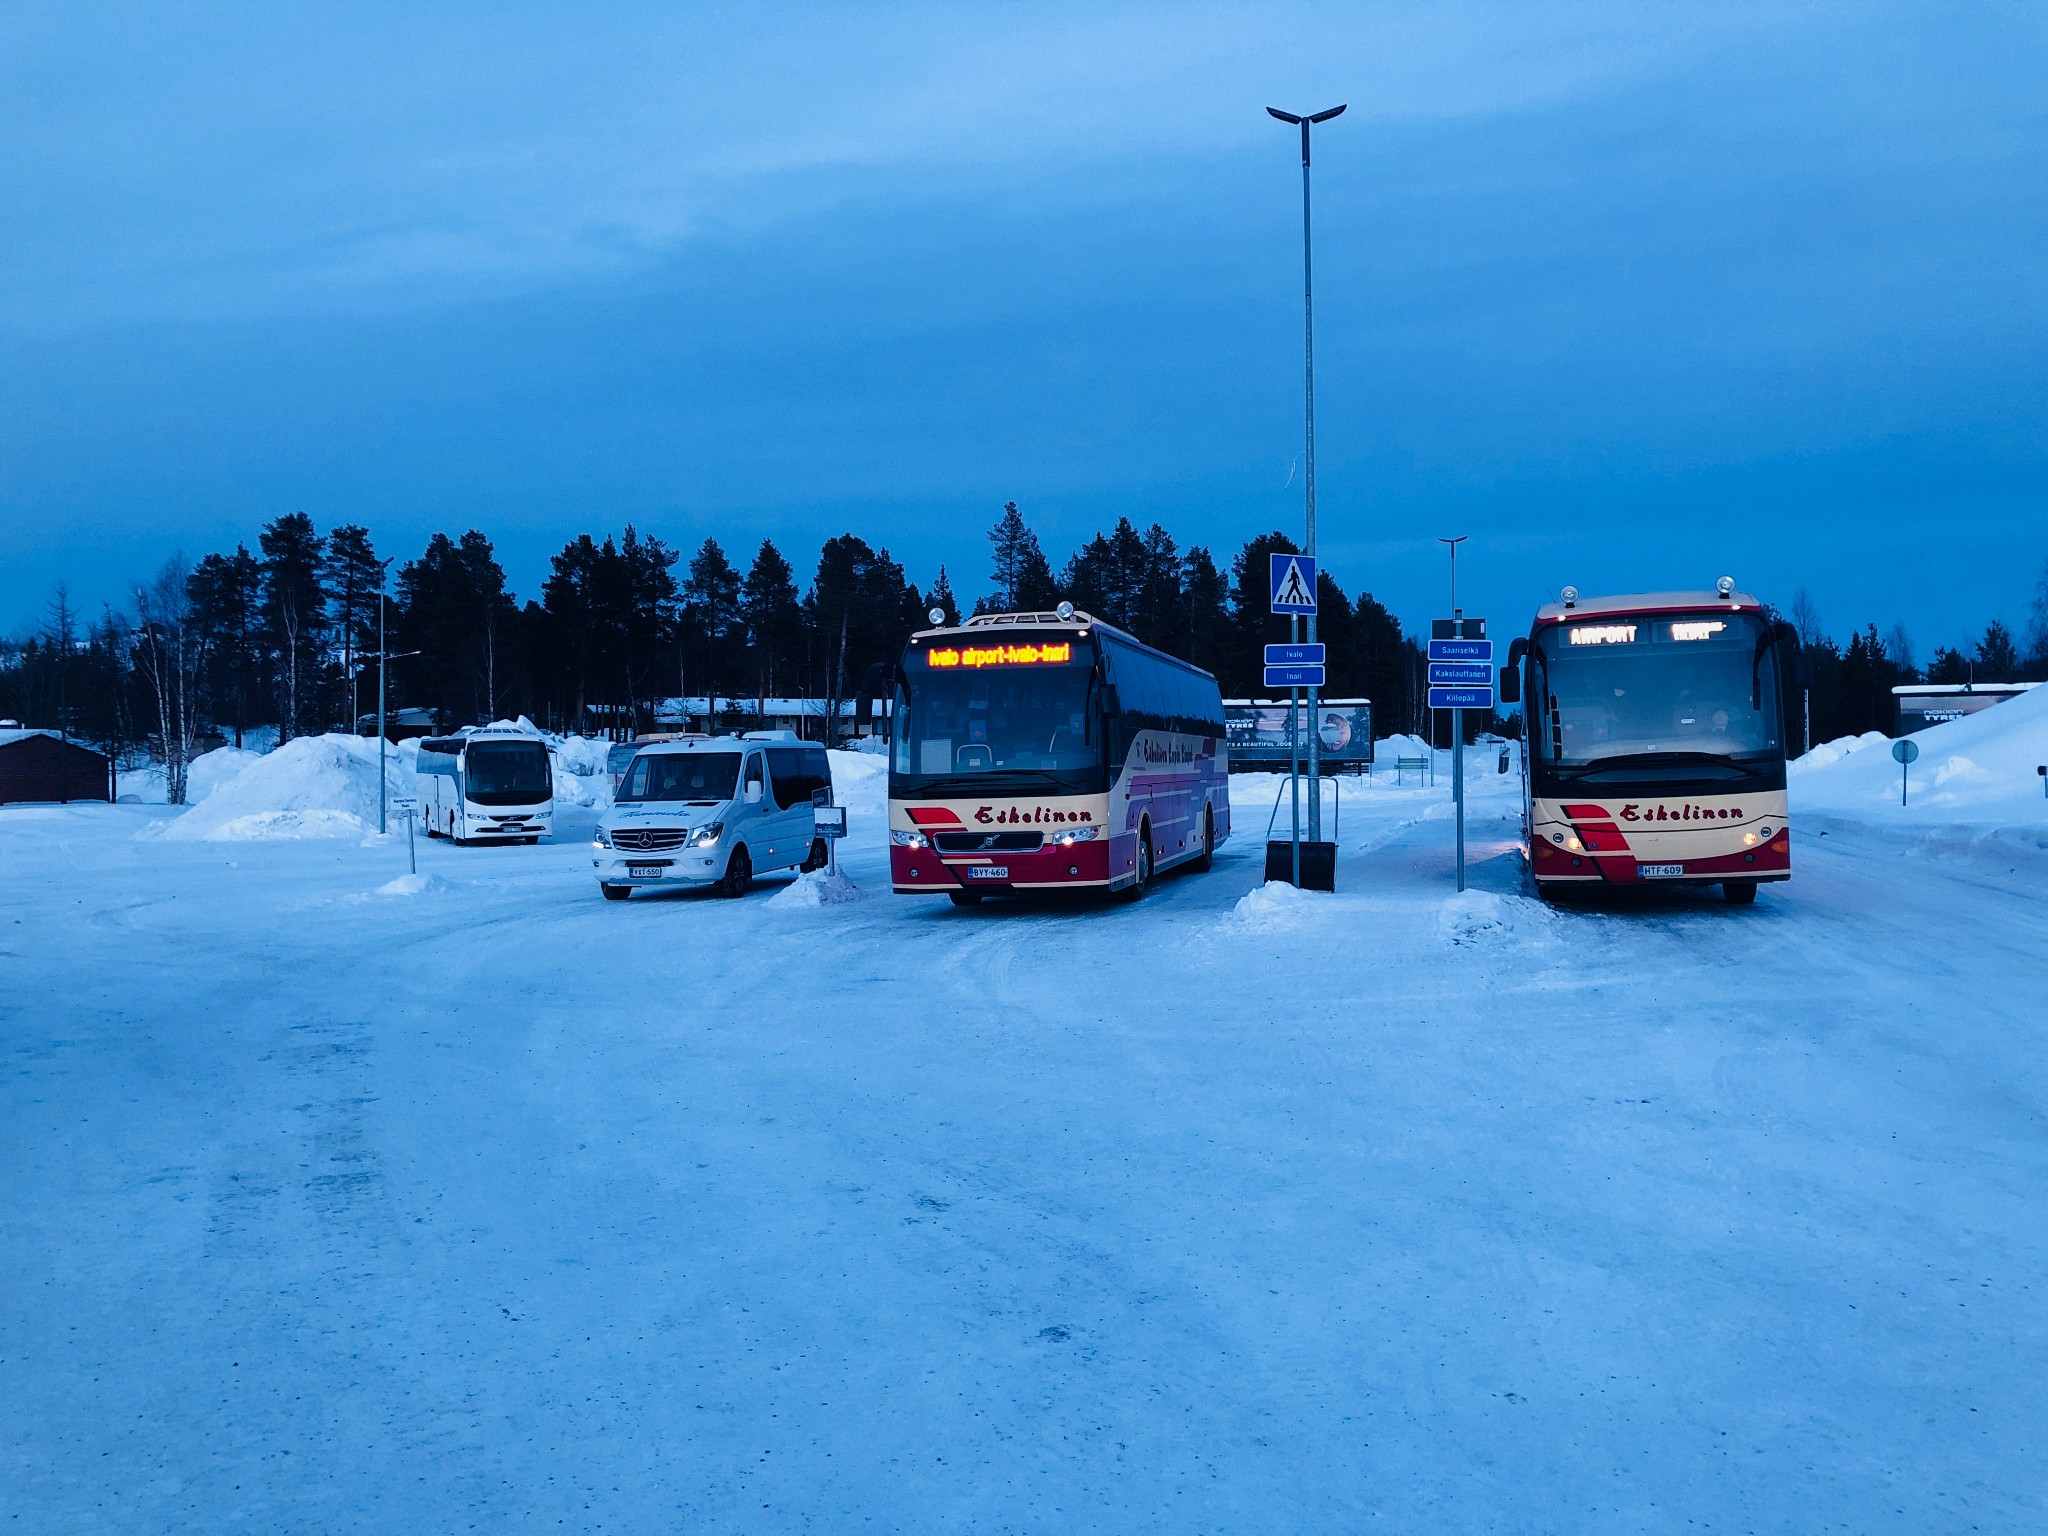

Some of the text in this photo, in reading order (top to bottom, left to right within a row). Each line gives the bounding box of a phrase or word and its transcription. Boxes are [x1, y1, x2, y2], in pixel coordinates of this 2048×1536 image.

[1571, 626, 1637, 645] AIRPORT
[1286, 650, 1303, 658] Ivalo
[1441, 646, 1479, 654] Saariselkä
[928, 648, 959, 667] Ivalo
[1286, 672, 1302, 680] Inari
[1435, 669, 1486, 678] Kakslauttanen
[1446, 693, 1476, 702] Kiilopää
[974, 806, 1092, 824] Eskelinen
[1620, 804, 1743, 821] Eskelinen
[973, 868, 1006, 877] BVY-460
[1644, 866, 1681, 875] HTF-609
